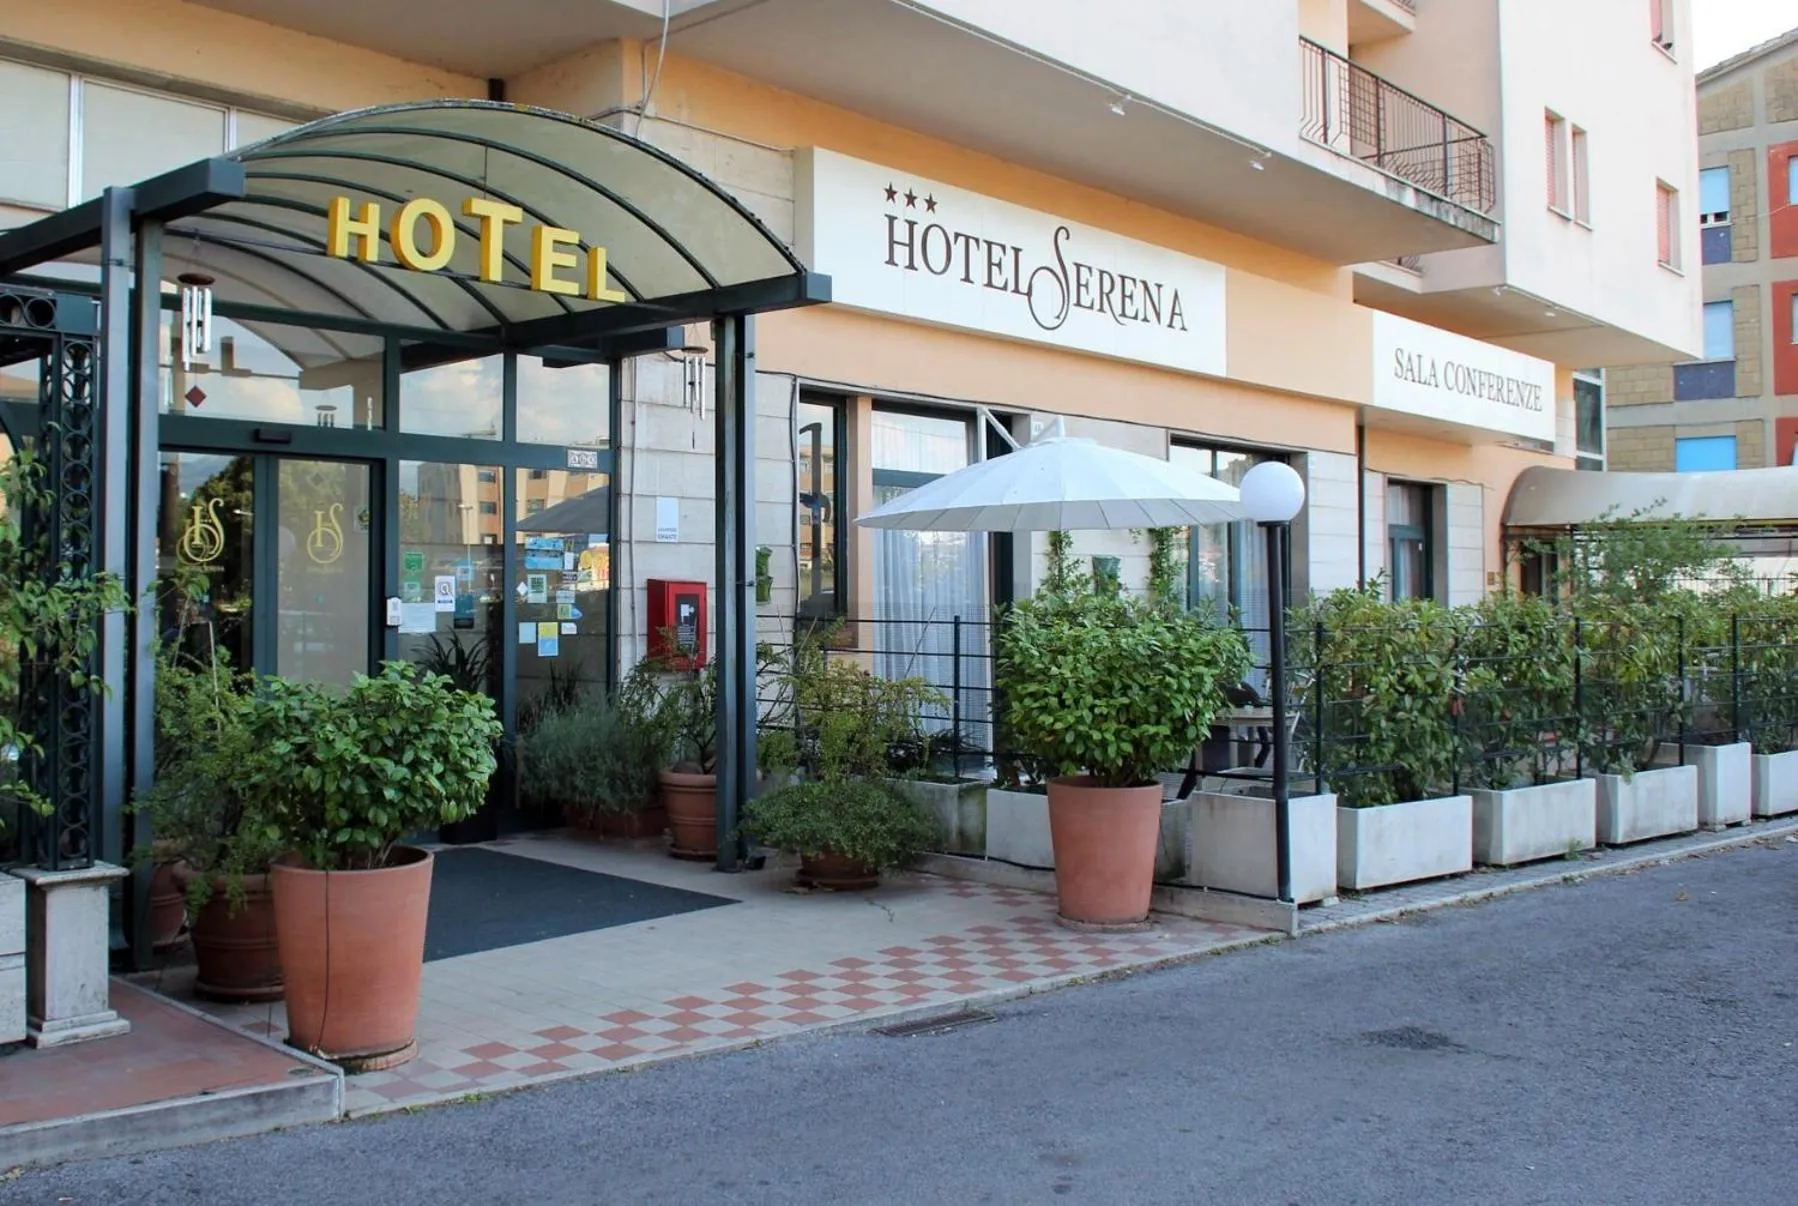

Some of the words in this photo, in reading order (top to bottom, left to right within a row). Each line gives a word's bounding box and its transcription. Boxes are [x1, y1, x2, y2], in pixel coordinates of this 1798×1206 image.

[326, 196, 626, 302] HOTEL
[884, 213, 1031, 298] HOTEL
[1028, 226, 1188, 331] SERENA
[1394, 347, 1439, 389] SALA
[1443, 361, 1543, 412] CONFERENZE
